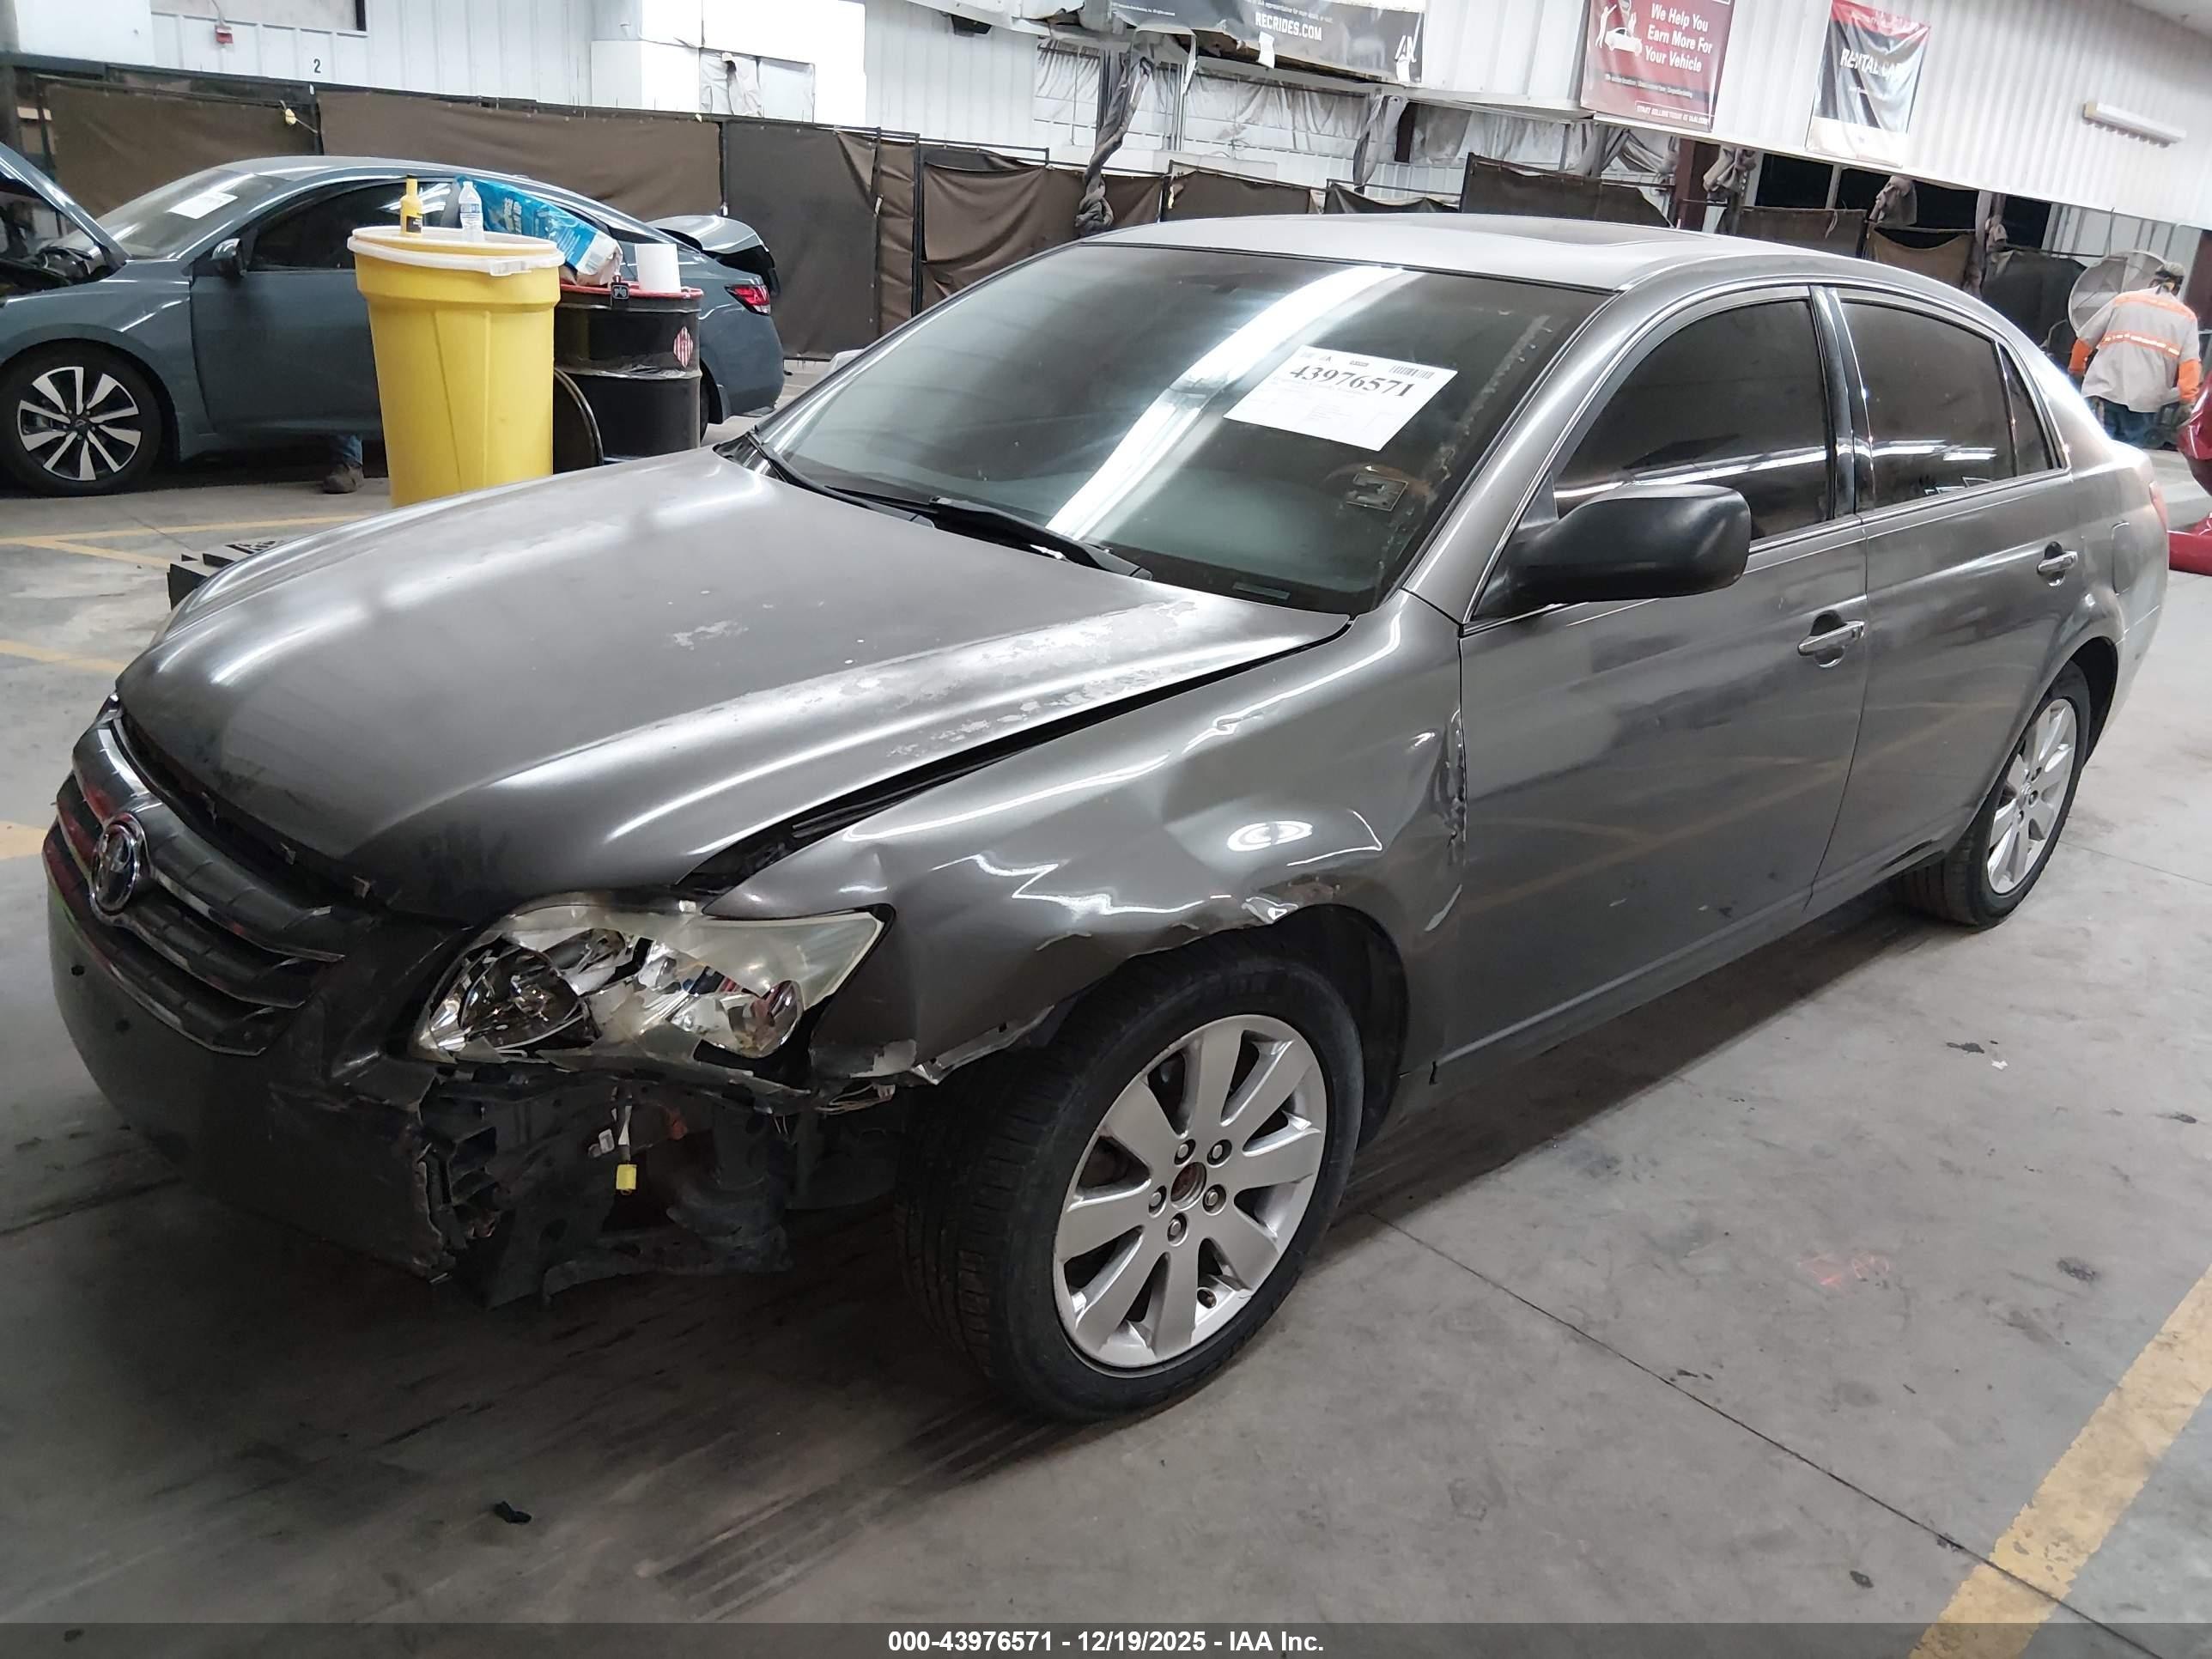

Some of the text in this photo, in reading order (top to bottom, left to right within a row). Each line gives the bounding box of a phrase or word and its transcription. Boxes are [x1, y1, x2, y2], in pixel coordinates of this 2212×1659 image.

[1255, 11, 1322, 41] RECRIDES.COM
[1650, 3, 1709, 33] We Help You
[1647, 24, 1713, 54] Earn More For
[313, 58, 321, 74] 2
[1644, 46, 1702, 72] Your Vehicle
[1840, 48, 1880, 76] RENTAL
[1290, 365, 1416, 397] 43976571
